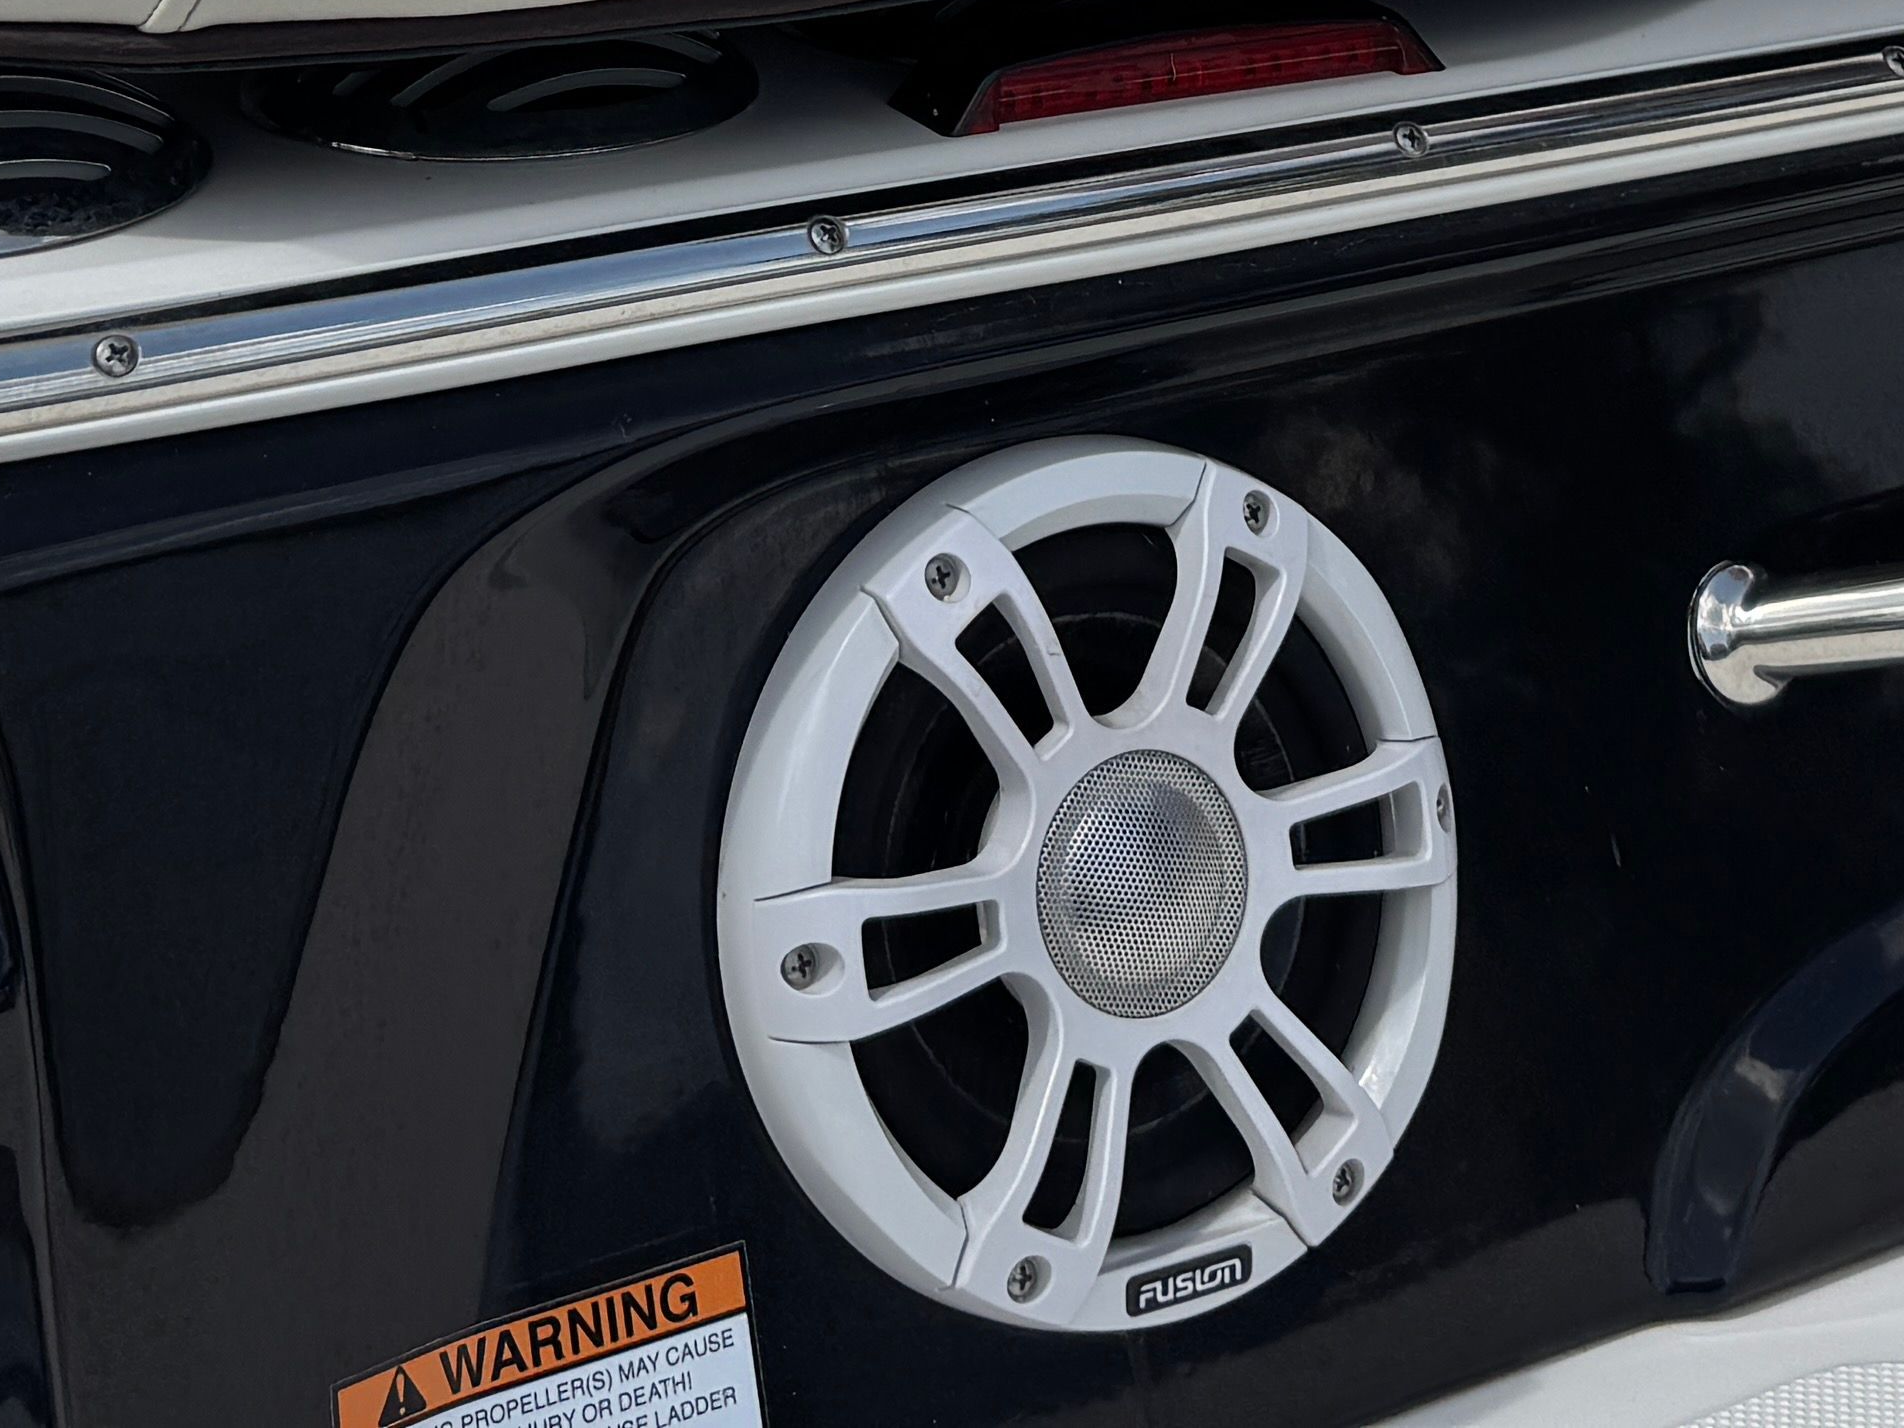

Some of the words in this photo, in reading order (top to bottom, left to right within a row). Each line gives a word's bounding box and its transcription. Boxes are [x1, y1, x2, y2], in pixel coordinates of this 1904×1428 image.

[1138, 1257, 1243, 1310] FUSION
[439, 1272, 698, 1395] WARNING
[461, 1369, 614, 1428] PROPELLER(S)
[618, 1351, 660, 1384] MAY
[665, 1328, 735, 1367] CAUSE
[582, 1398, 613, 1424] OR
[654, 1386, 738, 1428] LADDER
